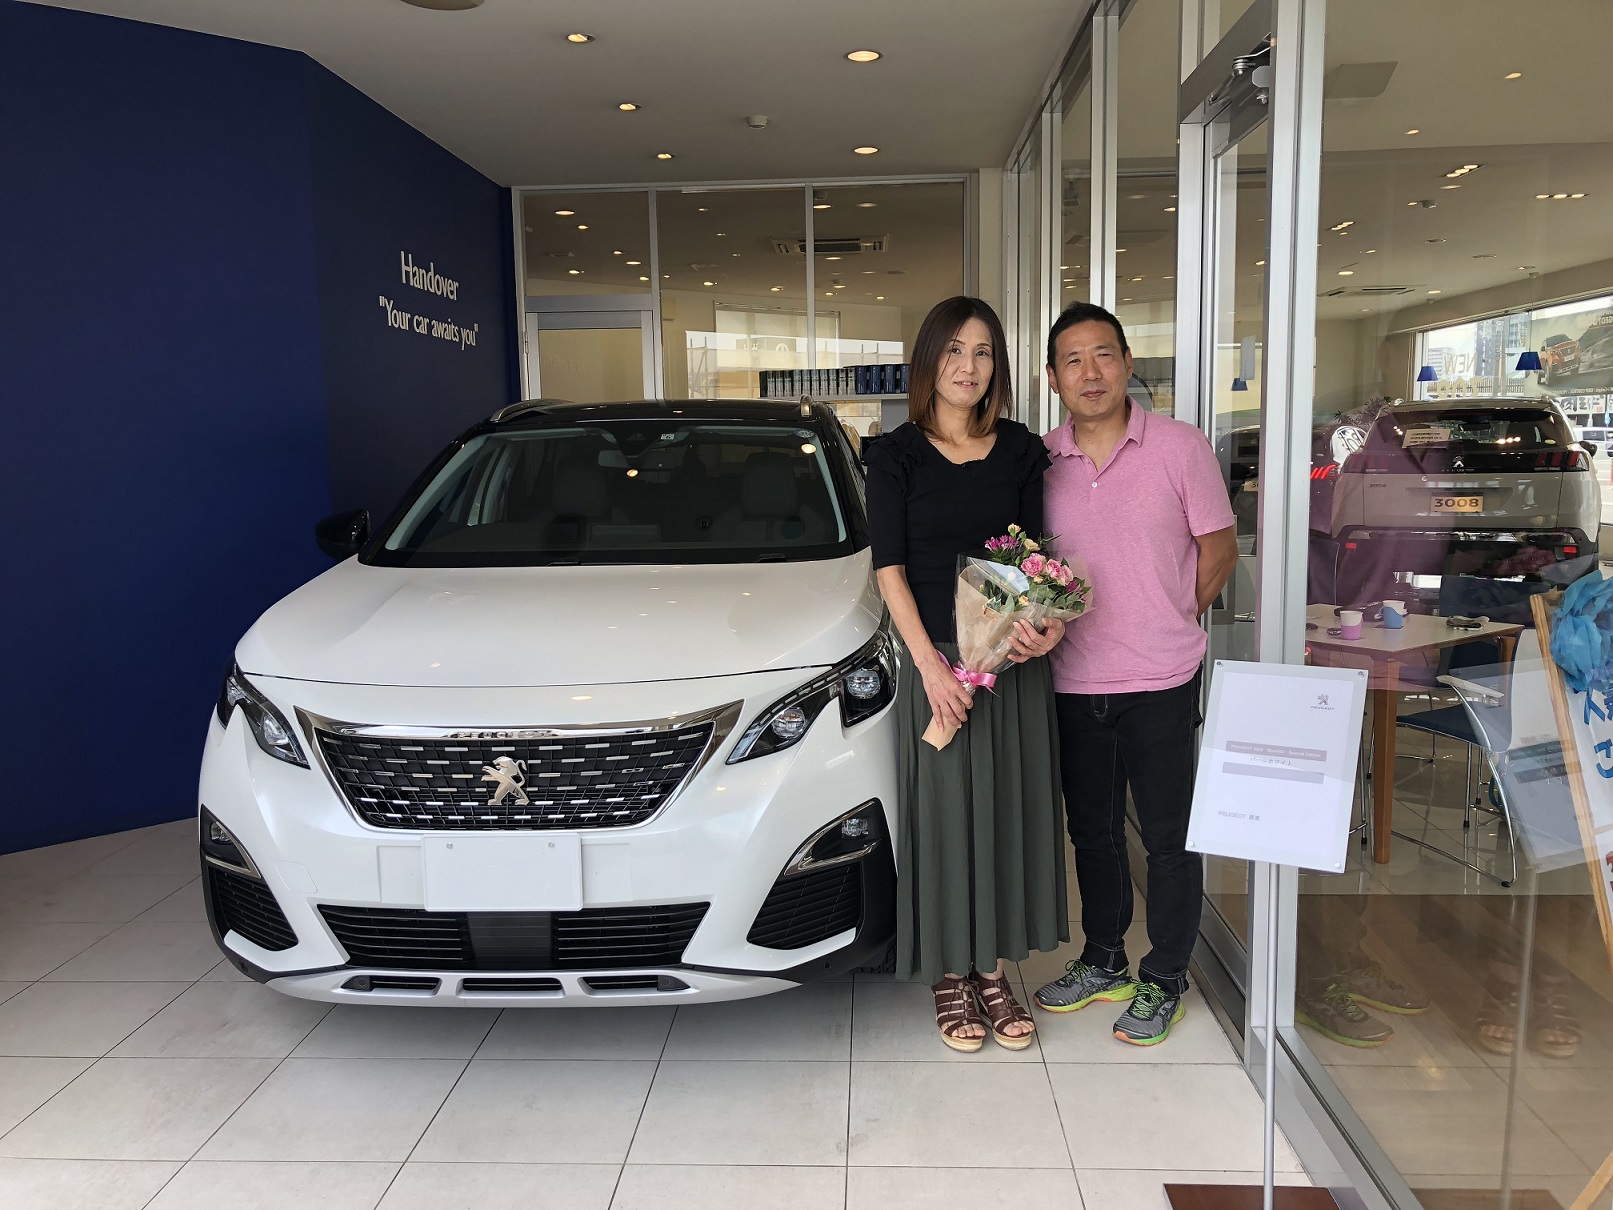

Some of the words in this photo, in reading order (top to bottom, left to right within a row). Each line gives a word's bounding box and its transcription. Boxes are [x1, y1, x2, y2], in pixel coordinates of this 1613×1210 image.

[401, 250, 459, 300] Handover
[379, 295, 411, 330] "Your
[413, 314, 430, 335] car
[431, 318, 459, 342] awaits
[460, 323, 479, 351] you"
[1434, 498, 1480, 508] 3008
[1250, 756, 1292, 767] パールホワイト
[1218, 810, 1246, 819] PEUGEOT
